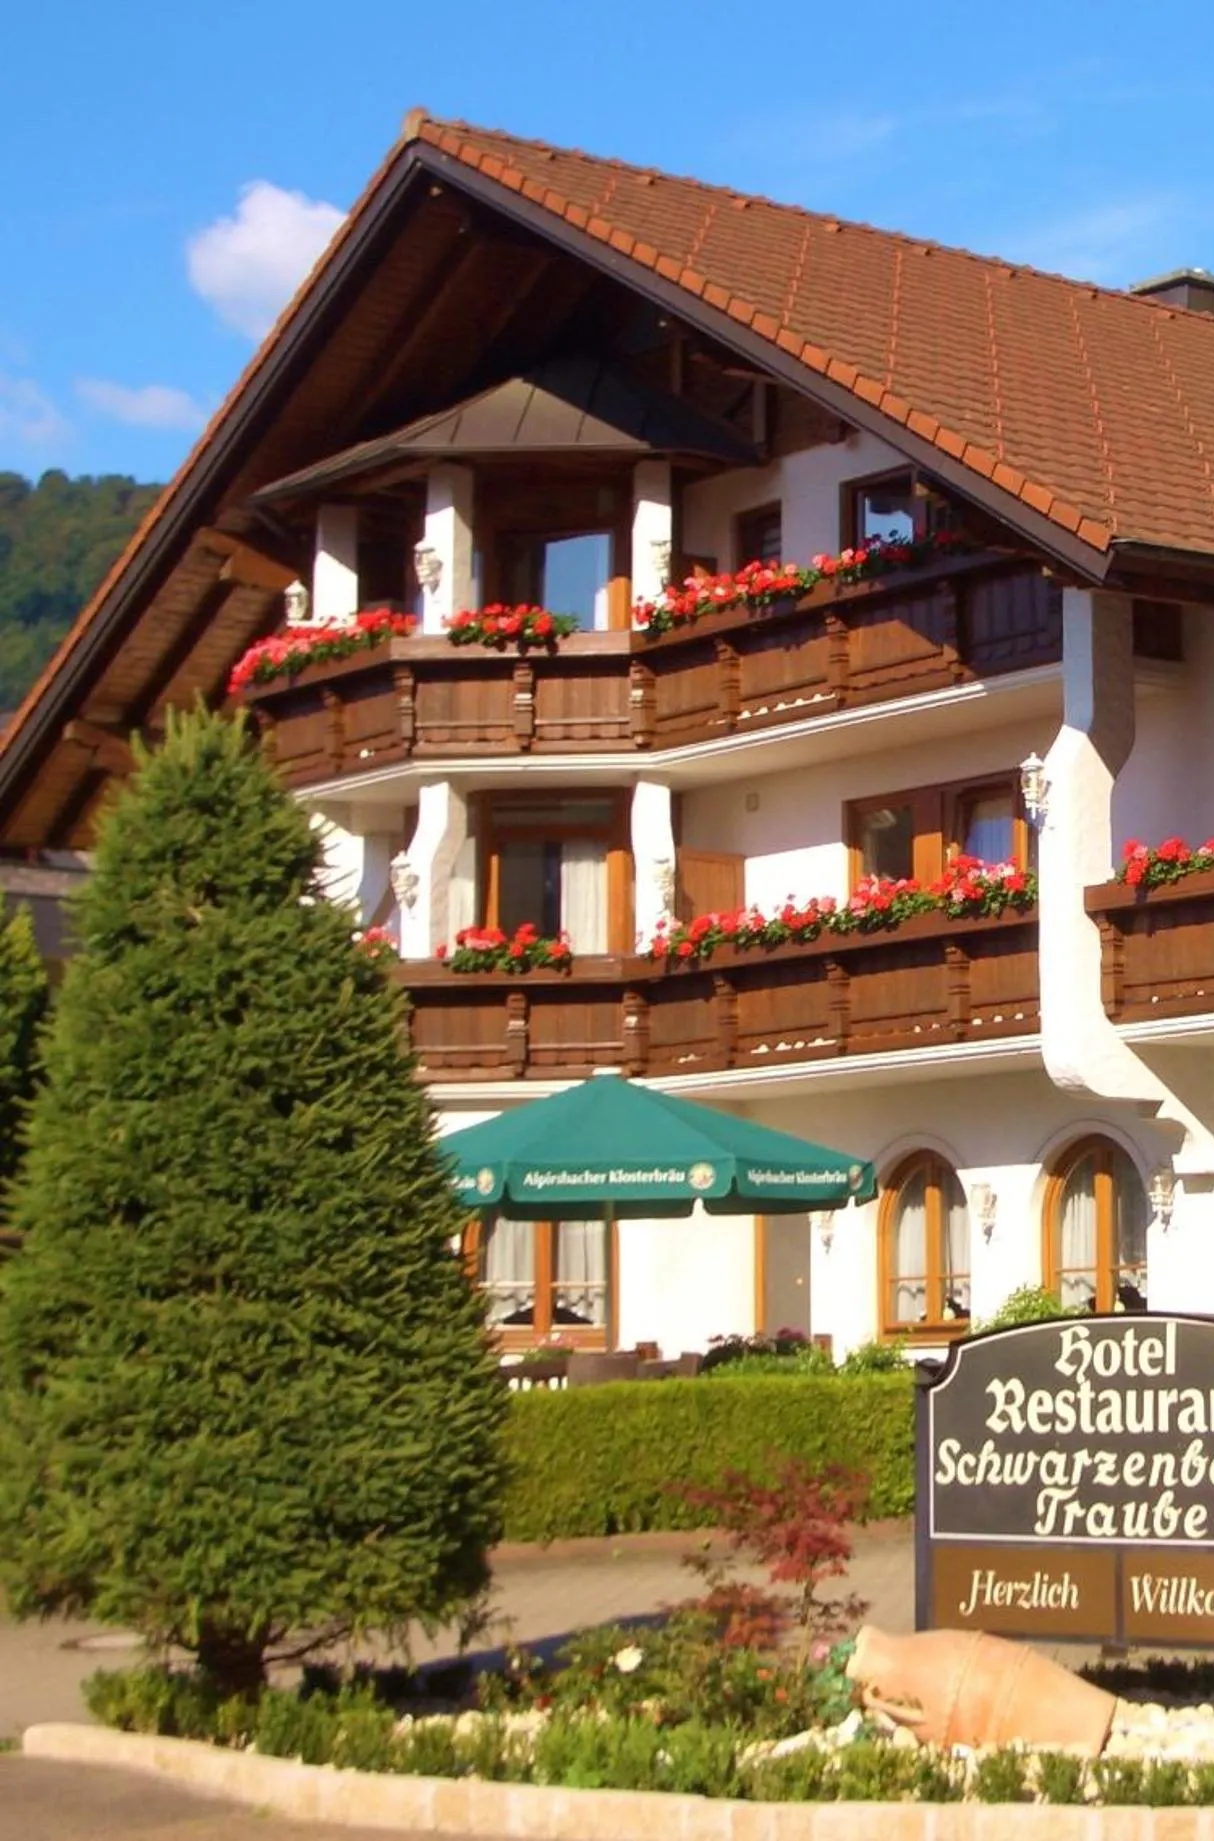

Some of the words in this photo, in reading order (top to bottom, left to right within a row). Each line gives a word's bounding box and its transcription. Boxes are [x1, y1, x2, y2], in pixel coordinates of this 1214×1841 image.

[608, 1168, 687, 1183] Klosterbräu
[1054, 1322, 1177, 1383] Hotel
[1034, 1488, 1209, 1539] Traube
[959, 1569, 1079, 1615] Herzlich
